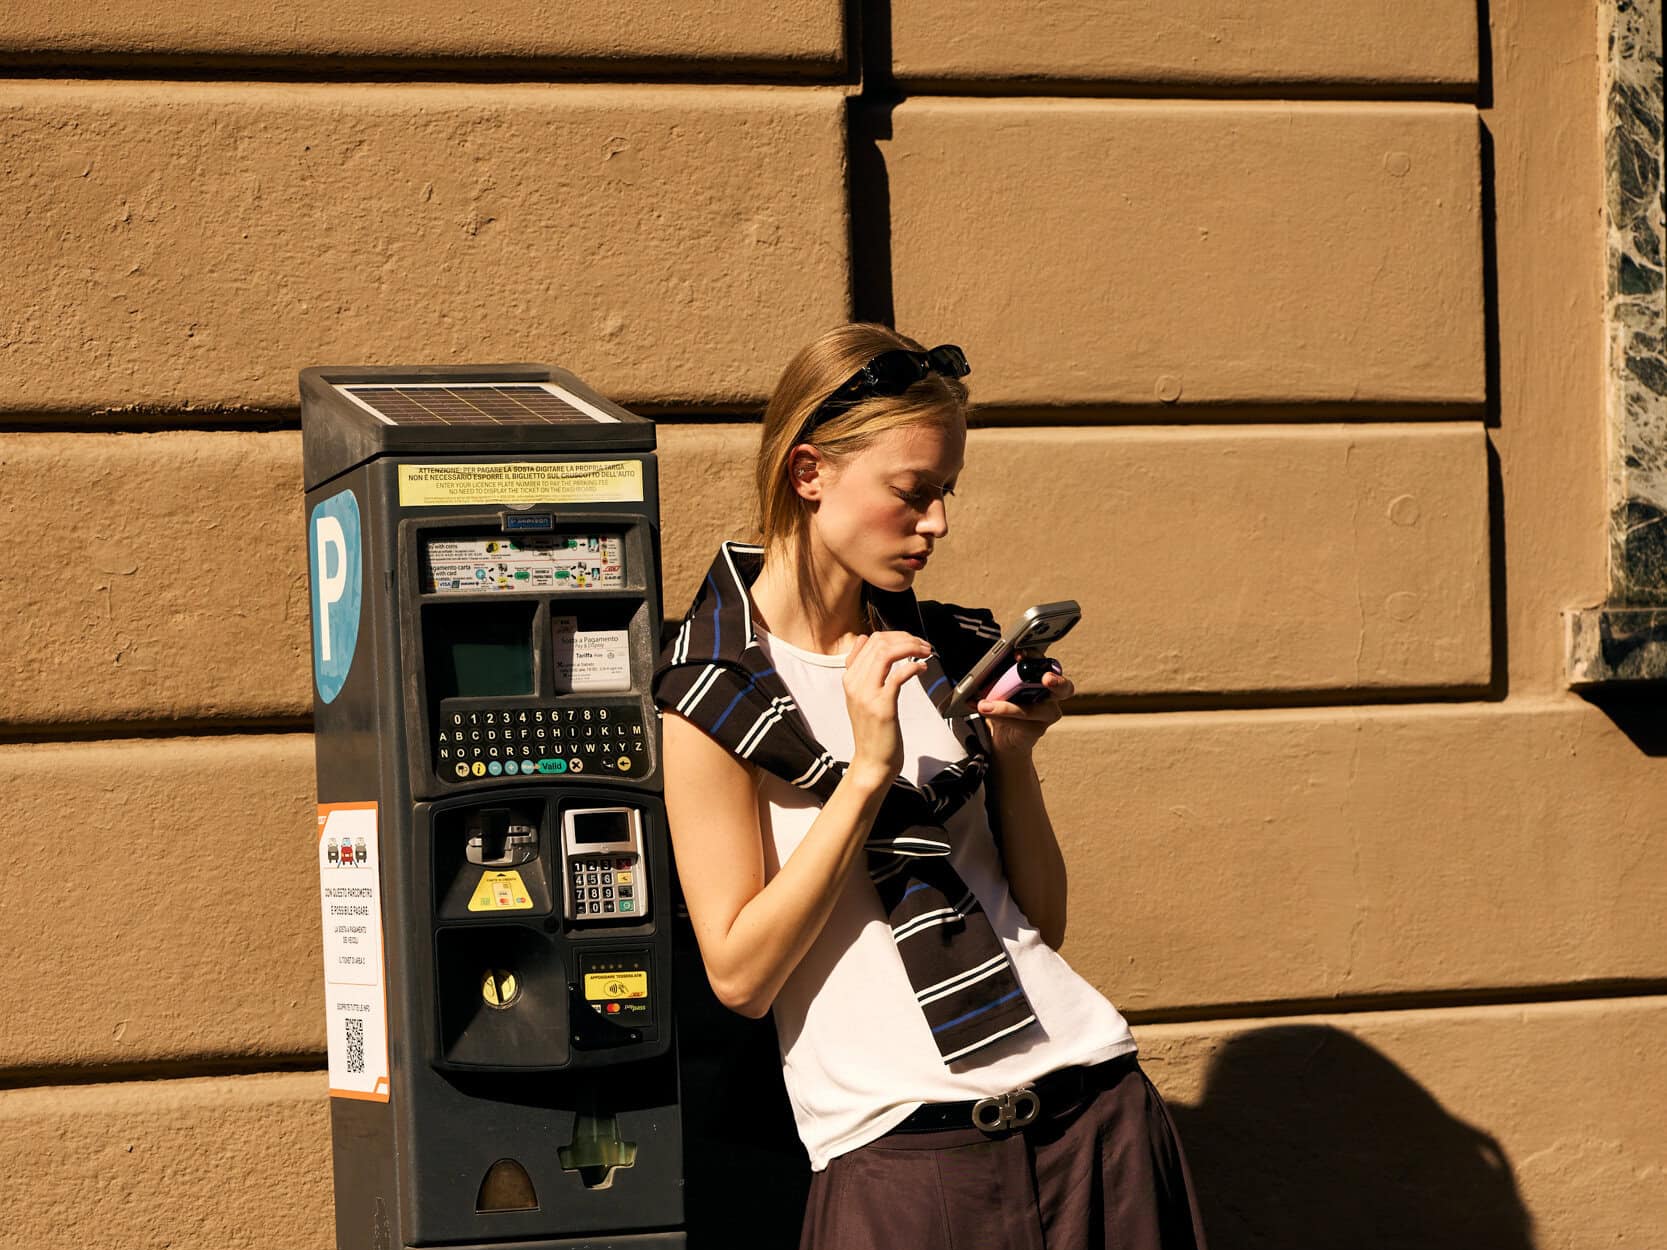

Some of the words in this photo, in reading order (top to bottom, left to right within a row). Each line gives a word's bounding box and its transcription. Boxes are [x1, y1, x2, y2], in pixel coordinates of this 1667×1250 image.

[513, 465, 535, 473] SOSTA
[430, 473, 472, 481] NECESSARIO
[512, 472, 546, 480] BIGLIETTO
[316, 516, 347, 661] P
[584, 635, 619, 643] Pagamento
[455, 715, 461, 724] 0
[471, 714, 476, 723] 1
[487, 714, 493, 723] 2
[504, 713, 510, 722] 3
[520, 712, 526, 722] 4
[536, 712, 542, 721] 5
[552, 711, 558, 721] 6
[568, 711, 574, 720] 7
[584, 710, 590, 720] 8
[600, 710, 606, 719] 9
[440, 733, 447, 741] A
[456, 732, 463, 740] B
[472, 731, 479, 740] C
[489, 731, 495, 739] D
[505, 730, 511, 738] E
[522, 730, 527, 738] F
[537, 729, 544, 737] G
[602, 727, 608, 735] K
[633, 726, 640, 734] M
[457, 749, 464, 757] O
[474, 748, 480, 756] P
[490, 748, 497, 756] Q
[507, 747, 513, 755] R
[523, 746, 529, 754] S
[539, 746, 545, 754] T
[555, 745, 561, 753] U
[586, 744, 595, 752] W
[603, 744, 610, 752] X
[619, 743, 625, 751] Y
[542, 761, 562, 770] Valid
[590, 874, 597, 884] 5
[604, 874, 611, 884] 6
[576, 889, 583, 898] 7
[591, 888, 598, 898] 8
[605, 888, 612, 898] 9
[592, 902, 599, 912] 0
